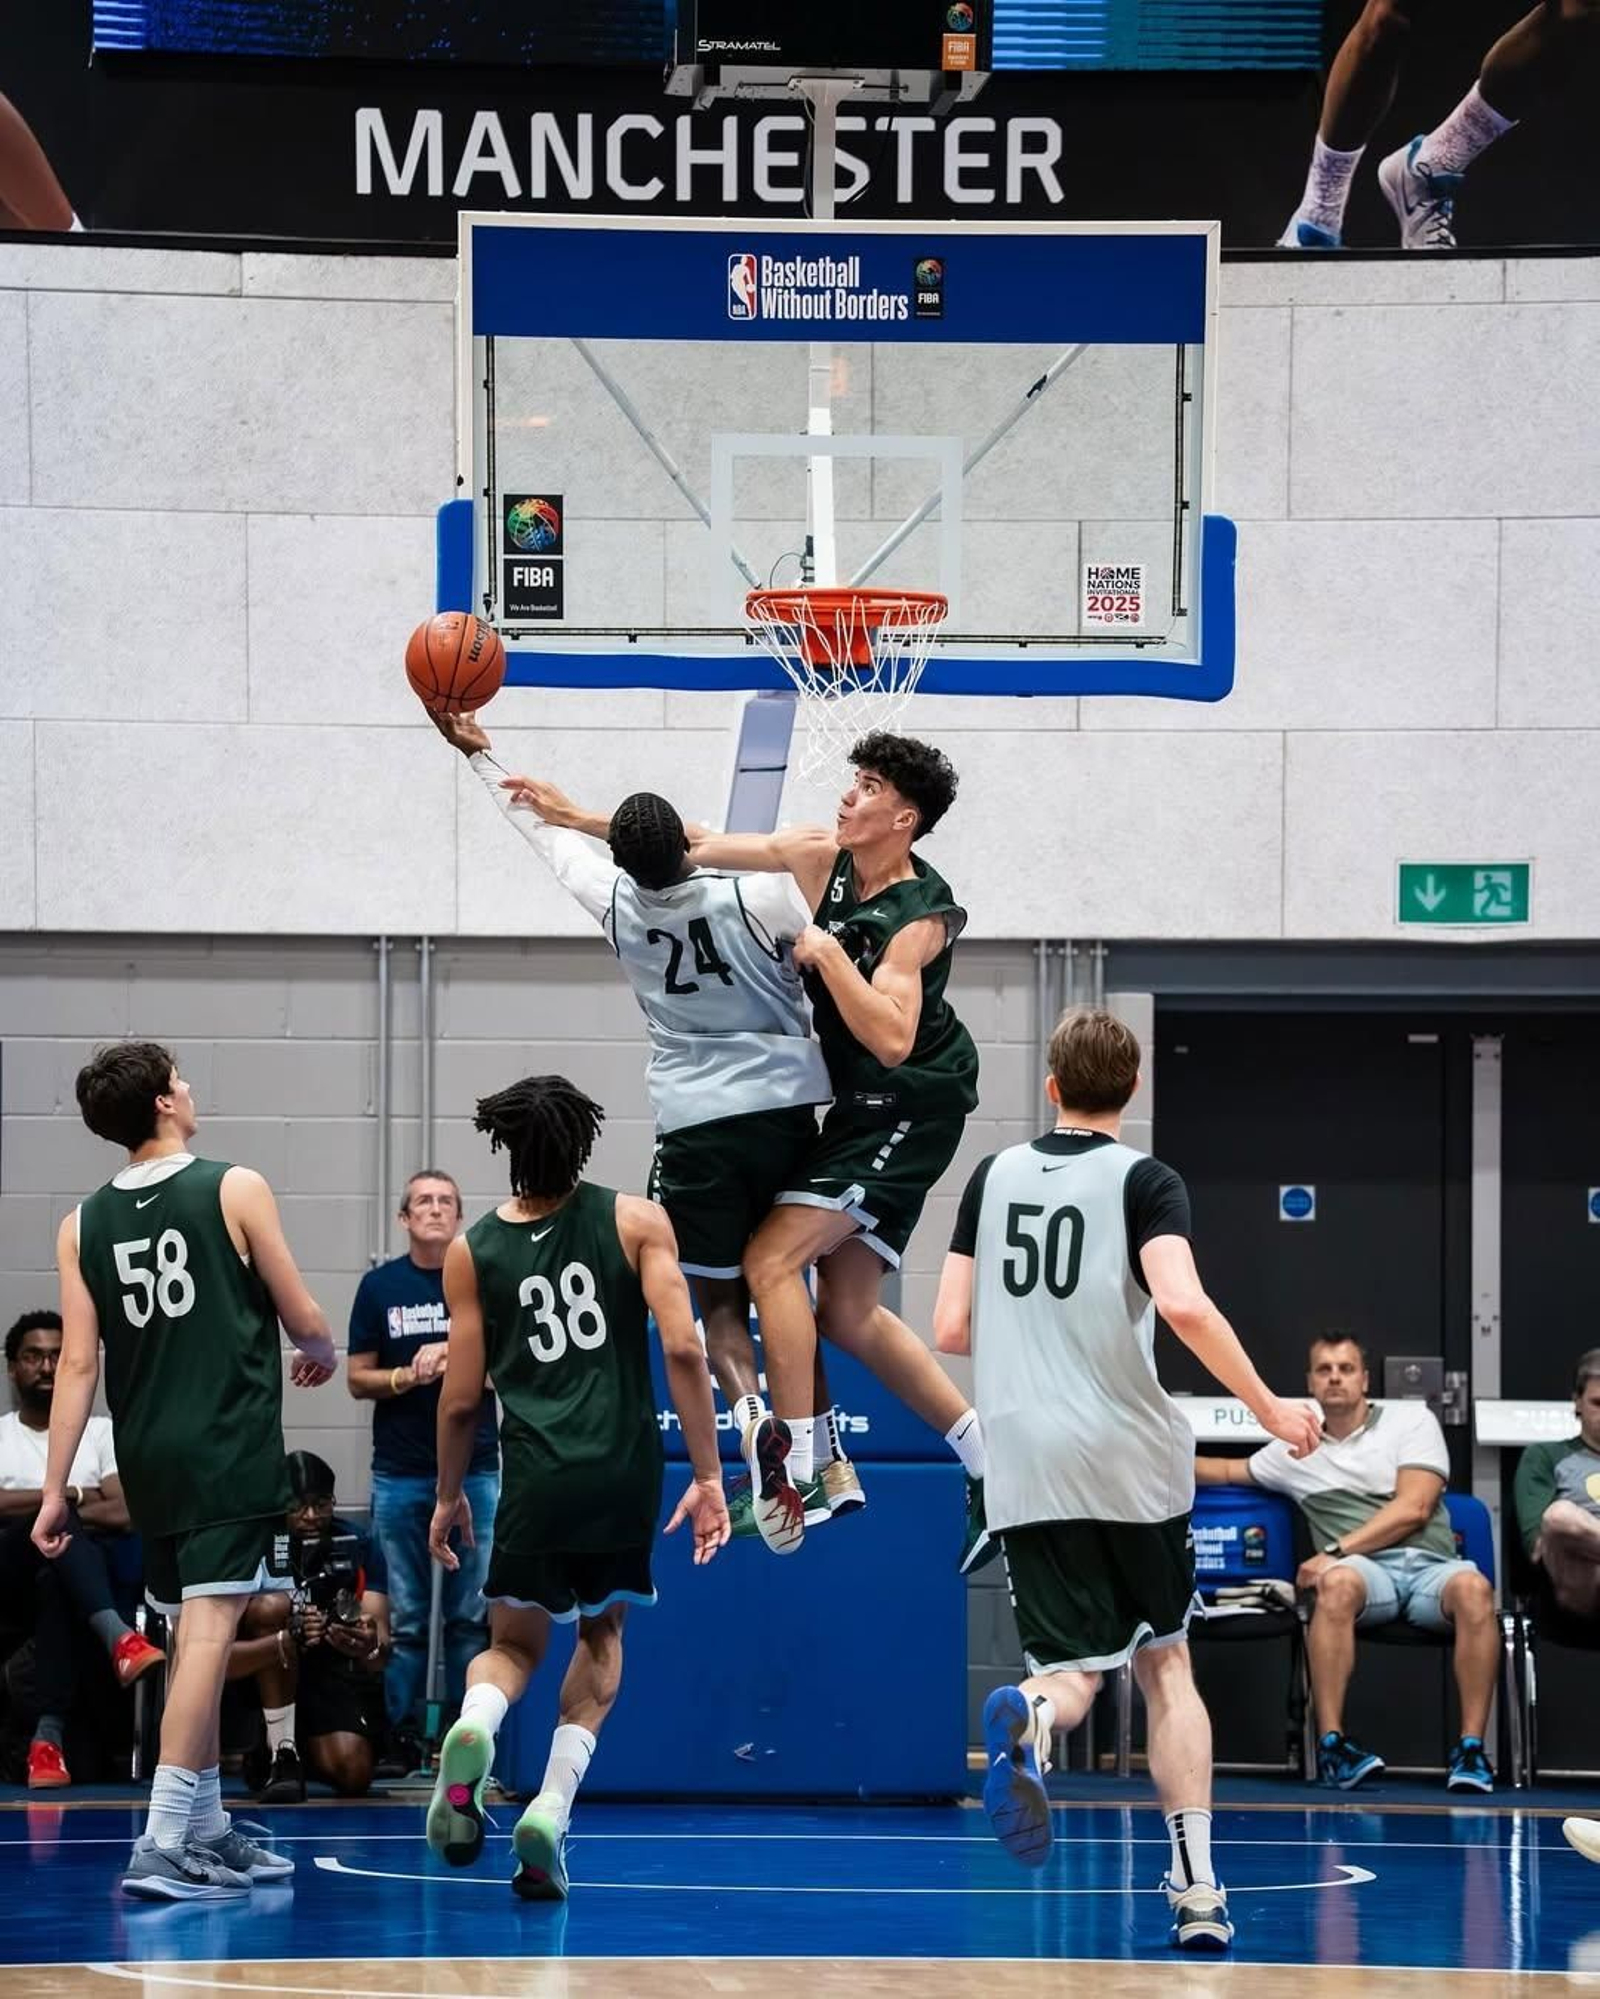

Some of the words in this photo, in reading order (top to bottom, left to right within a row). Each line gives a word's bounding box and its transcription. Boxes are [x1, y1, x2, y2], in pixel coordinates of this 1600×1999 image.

[697, 40, 781, 52] STRAMATEL
[355, 107, 1065, 204] MANCHESTER
[761, 255, 860, 287] Basketball
[761, 288, 832, 319] Without
[835, 288, 909, 320] Borders
[918, 292, 940, 304] FIBA
[513, 567, 554, 587] FIBA
[1087, 580, 1141, 590] NATIONS
[1087, 596, 1141, 612] 2025
[647, 916, 735, 994] 24
[1003, 1202, 1085, 1299] 50
[113, 1229, 196, 1329] 58
[518, 1261, 607, 1363] 38
[1214, 1408, 1258, 1425] PUS
